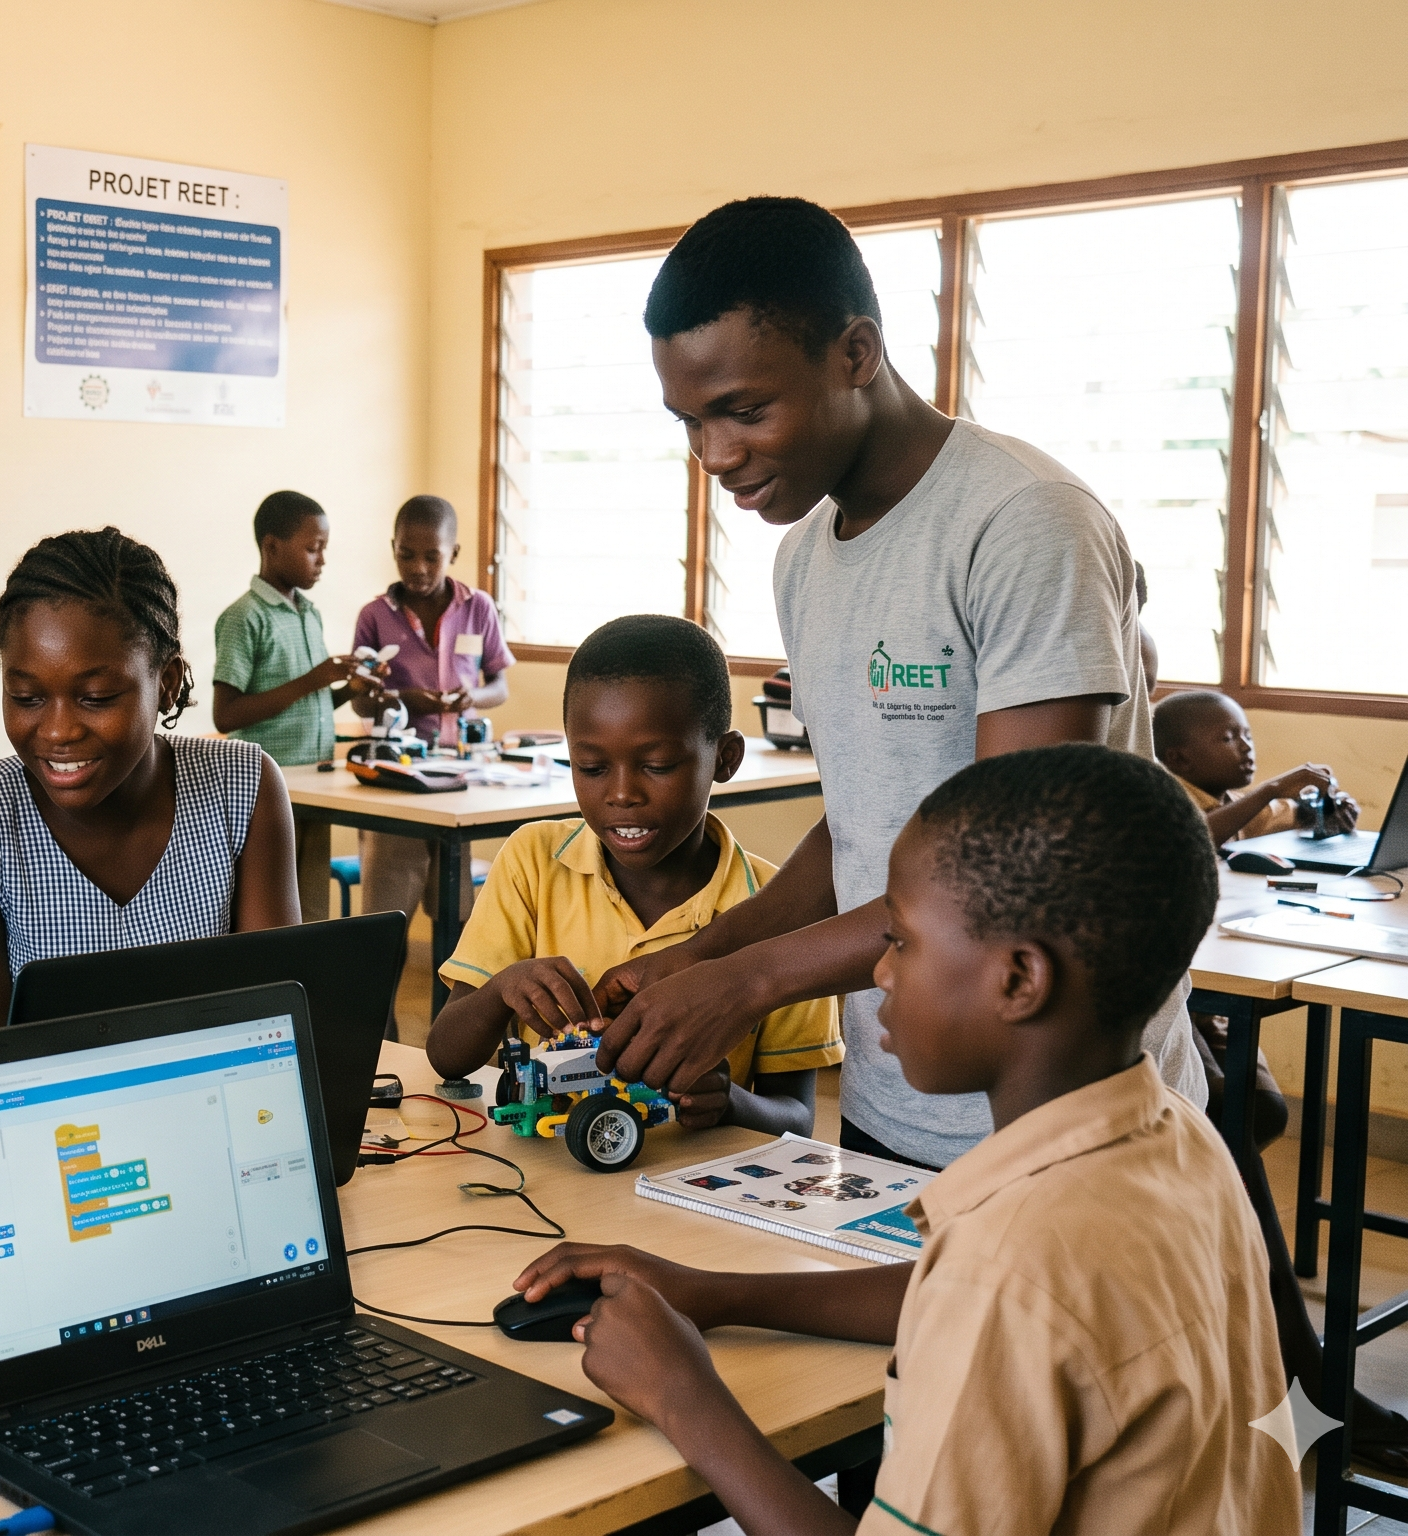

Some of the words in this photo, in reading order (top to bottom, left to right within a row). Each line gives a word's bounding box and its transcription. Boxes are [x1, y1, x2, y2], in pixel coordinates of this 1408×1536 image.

[89, 168, 171, 200] PROJET
[178, 181, 229, 208] REET
[891, 663, 952, 689] REET
[136, 1334, 167, 1353] DELL
